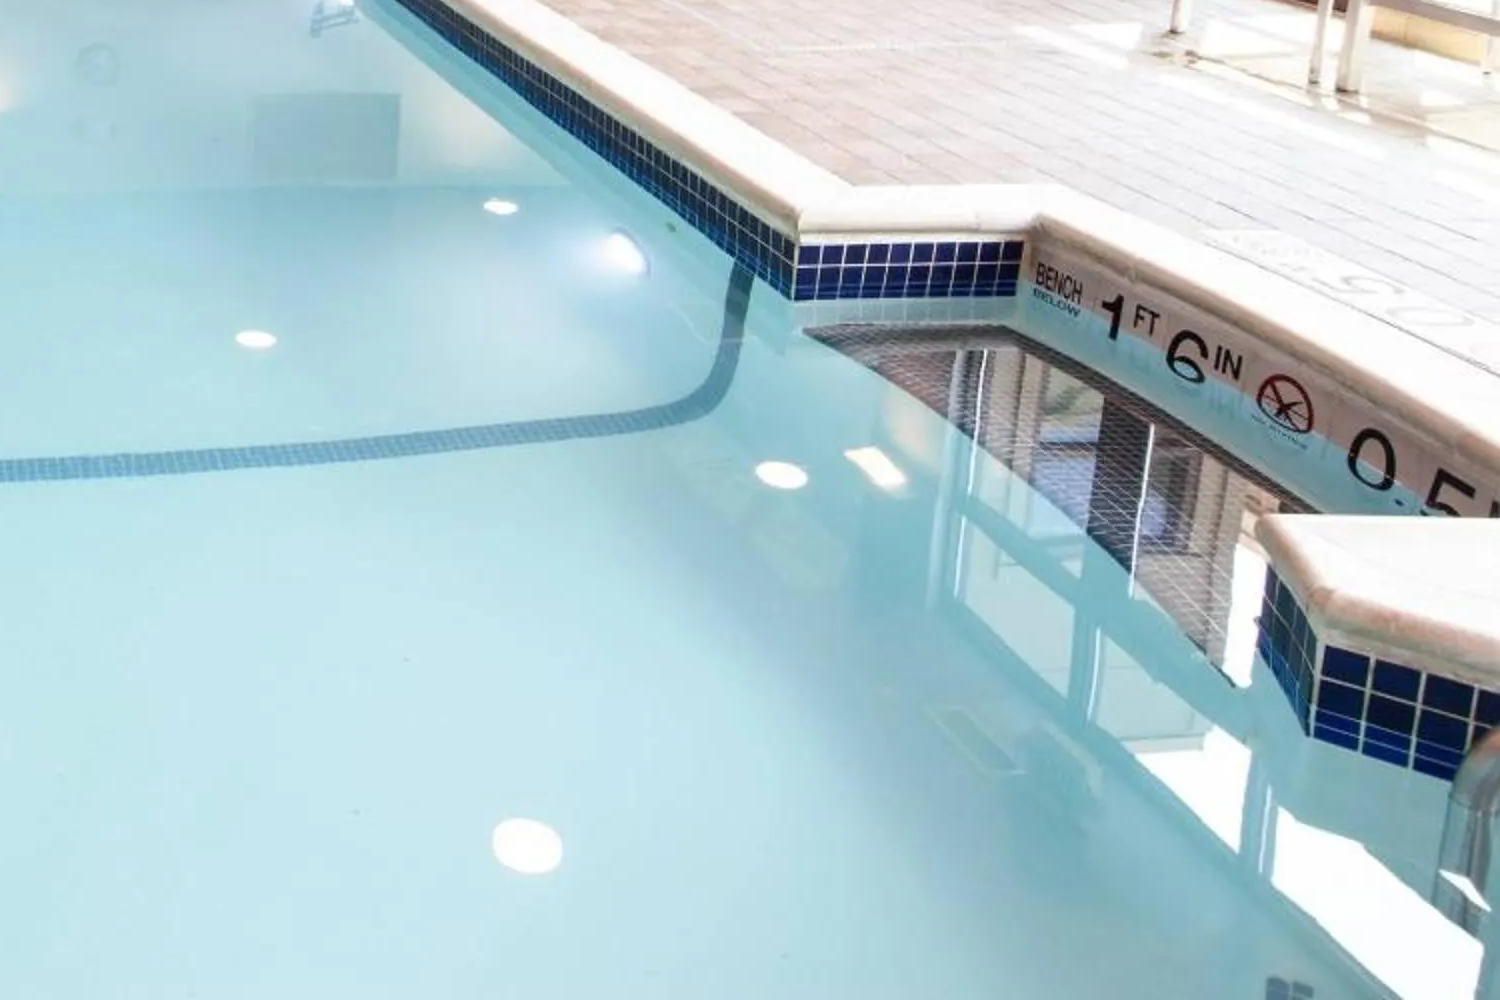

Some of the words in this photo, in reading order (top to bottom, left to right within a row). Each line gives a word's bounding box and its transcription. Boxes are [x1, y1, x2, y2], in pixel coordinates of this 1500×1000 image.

[1035, 262, 1083, 305] BENCH
[1101, 293, 1125, 341] 1
[1133, 304, 1161, 337] FT
[1166, 329, 1209, 384] 6
[1213, 344, 1243, 382] IN
